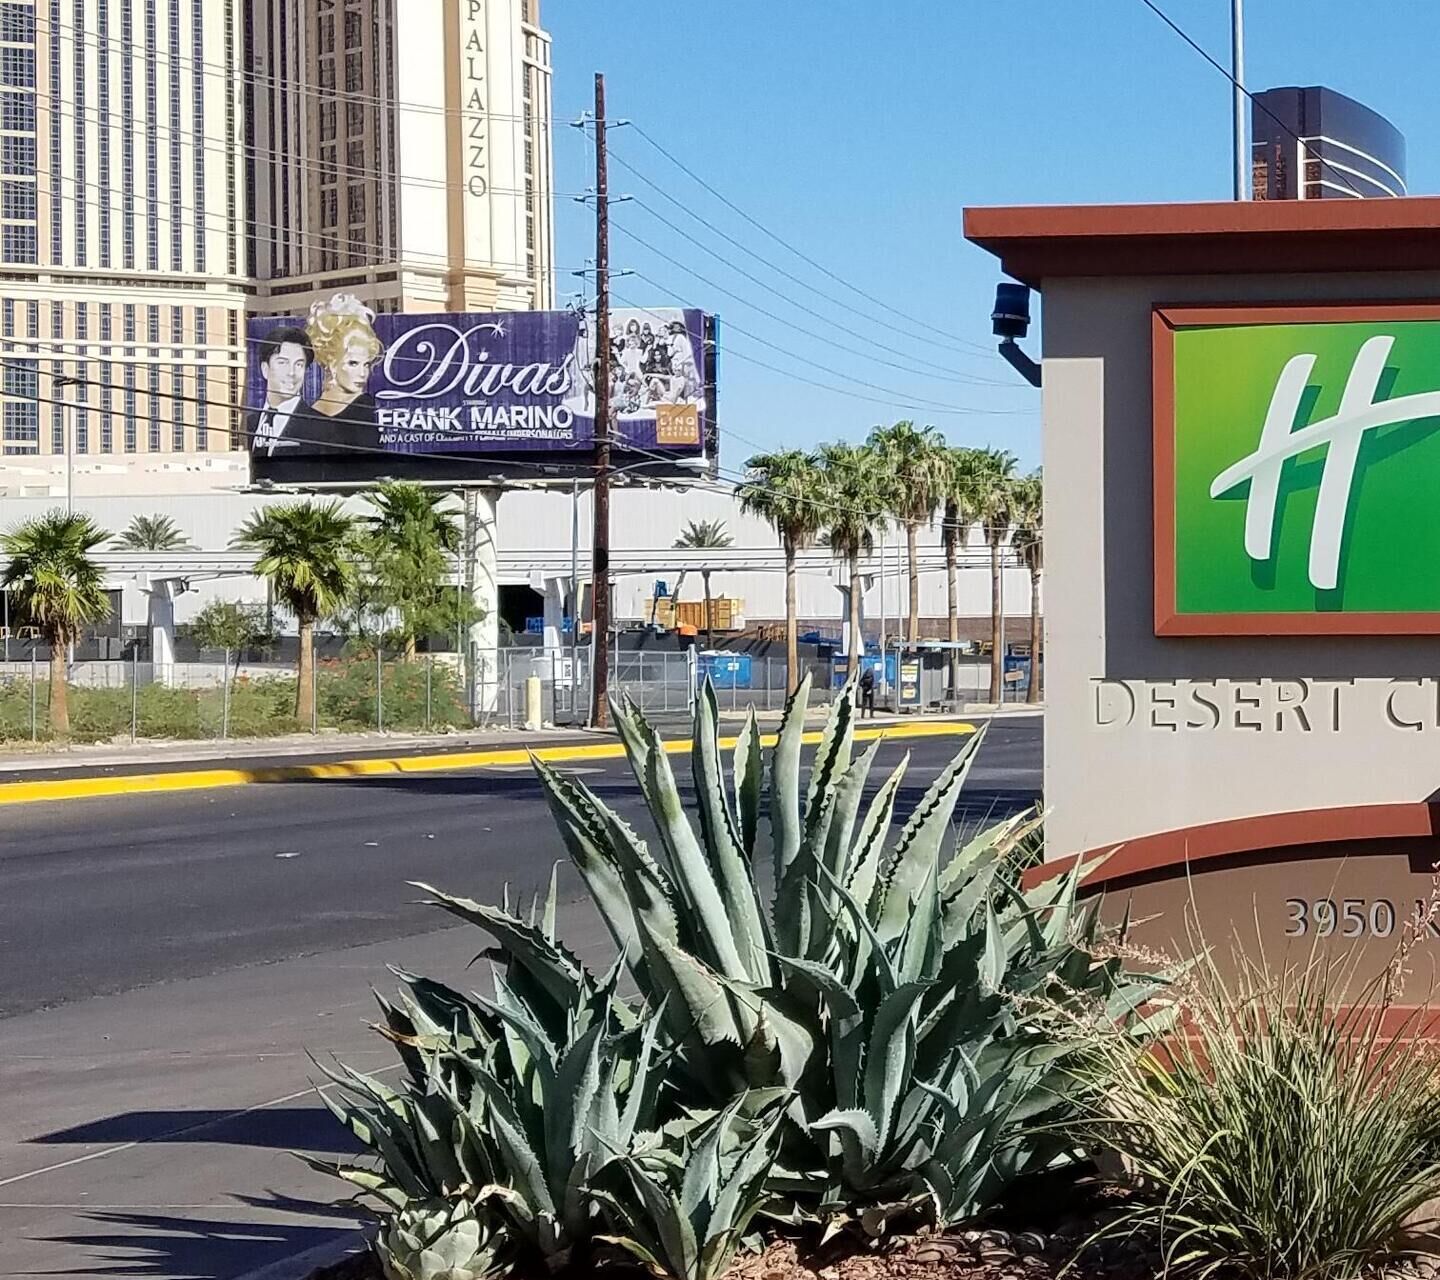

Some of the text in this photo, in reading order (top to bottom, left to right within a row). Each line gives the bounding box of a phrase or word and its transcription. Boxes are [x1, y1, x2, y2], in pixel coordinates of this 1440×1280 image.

[375, 321, 575, 400] Divas
[377, 404, 574, 431] FRANK MARINO
[378, 433, 397, 444] AND
[397, 433, 404, 443] A
[404, 432, 425, 443] CAST
[425, 432, 436, 442] OF
[1092, 677, 1355, 733] DESERT
[1284, 897, 1396, 939] 3950
